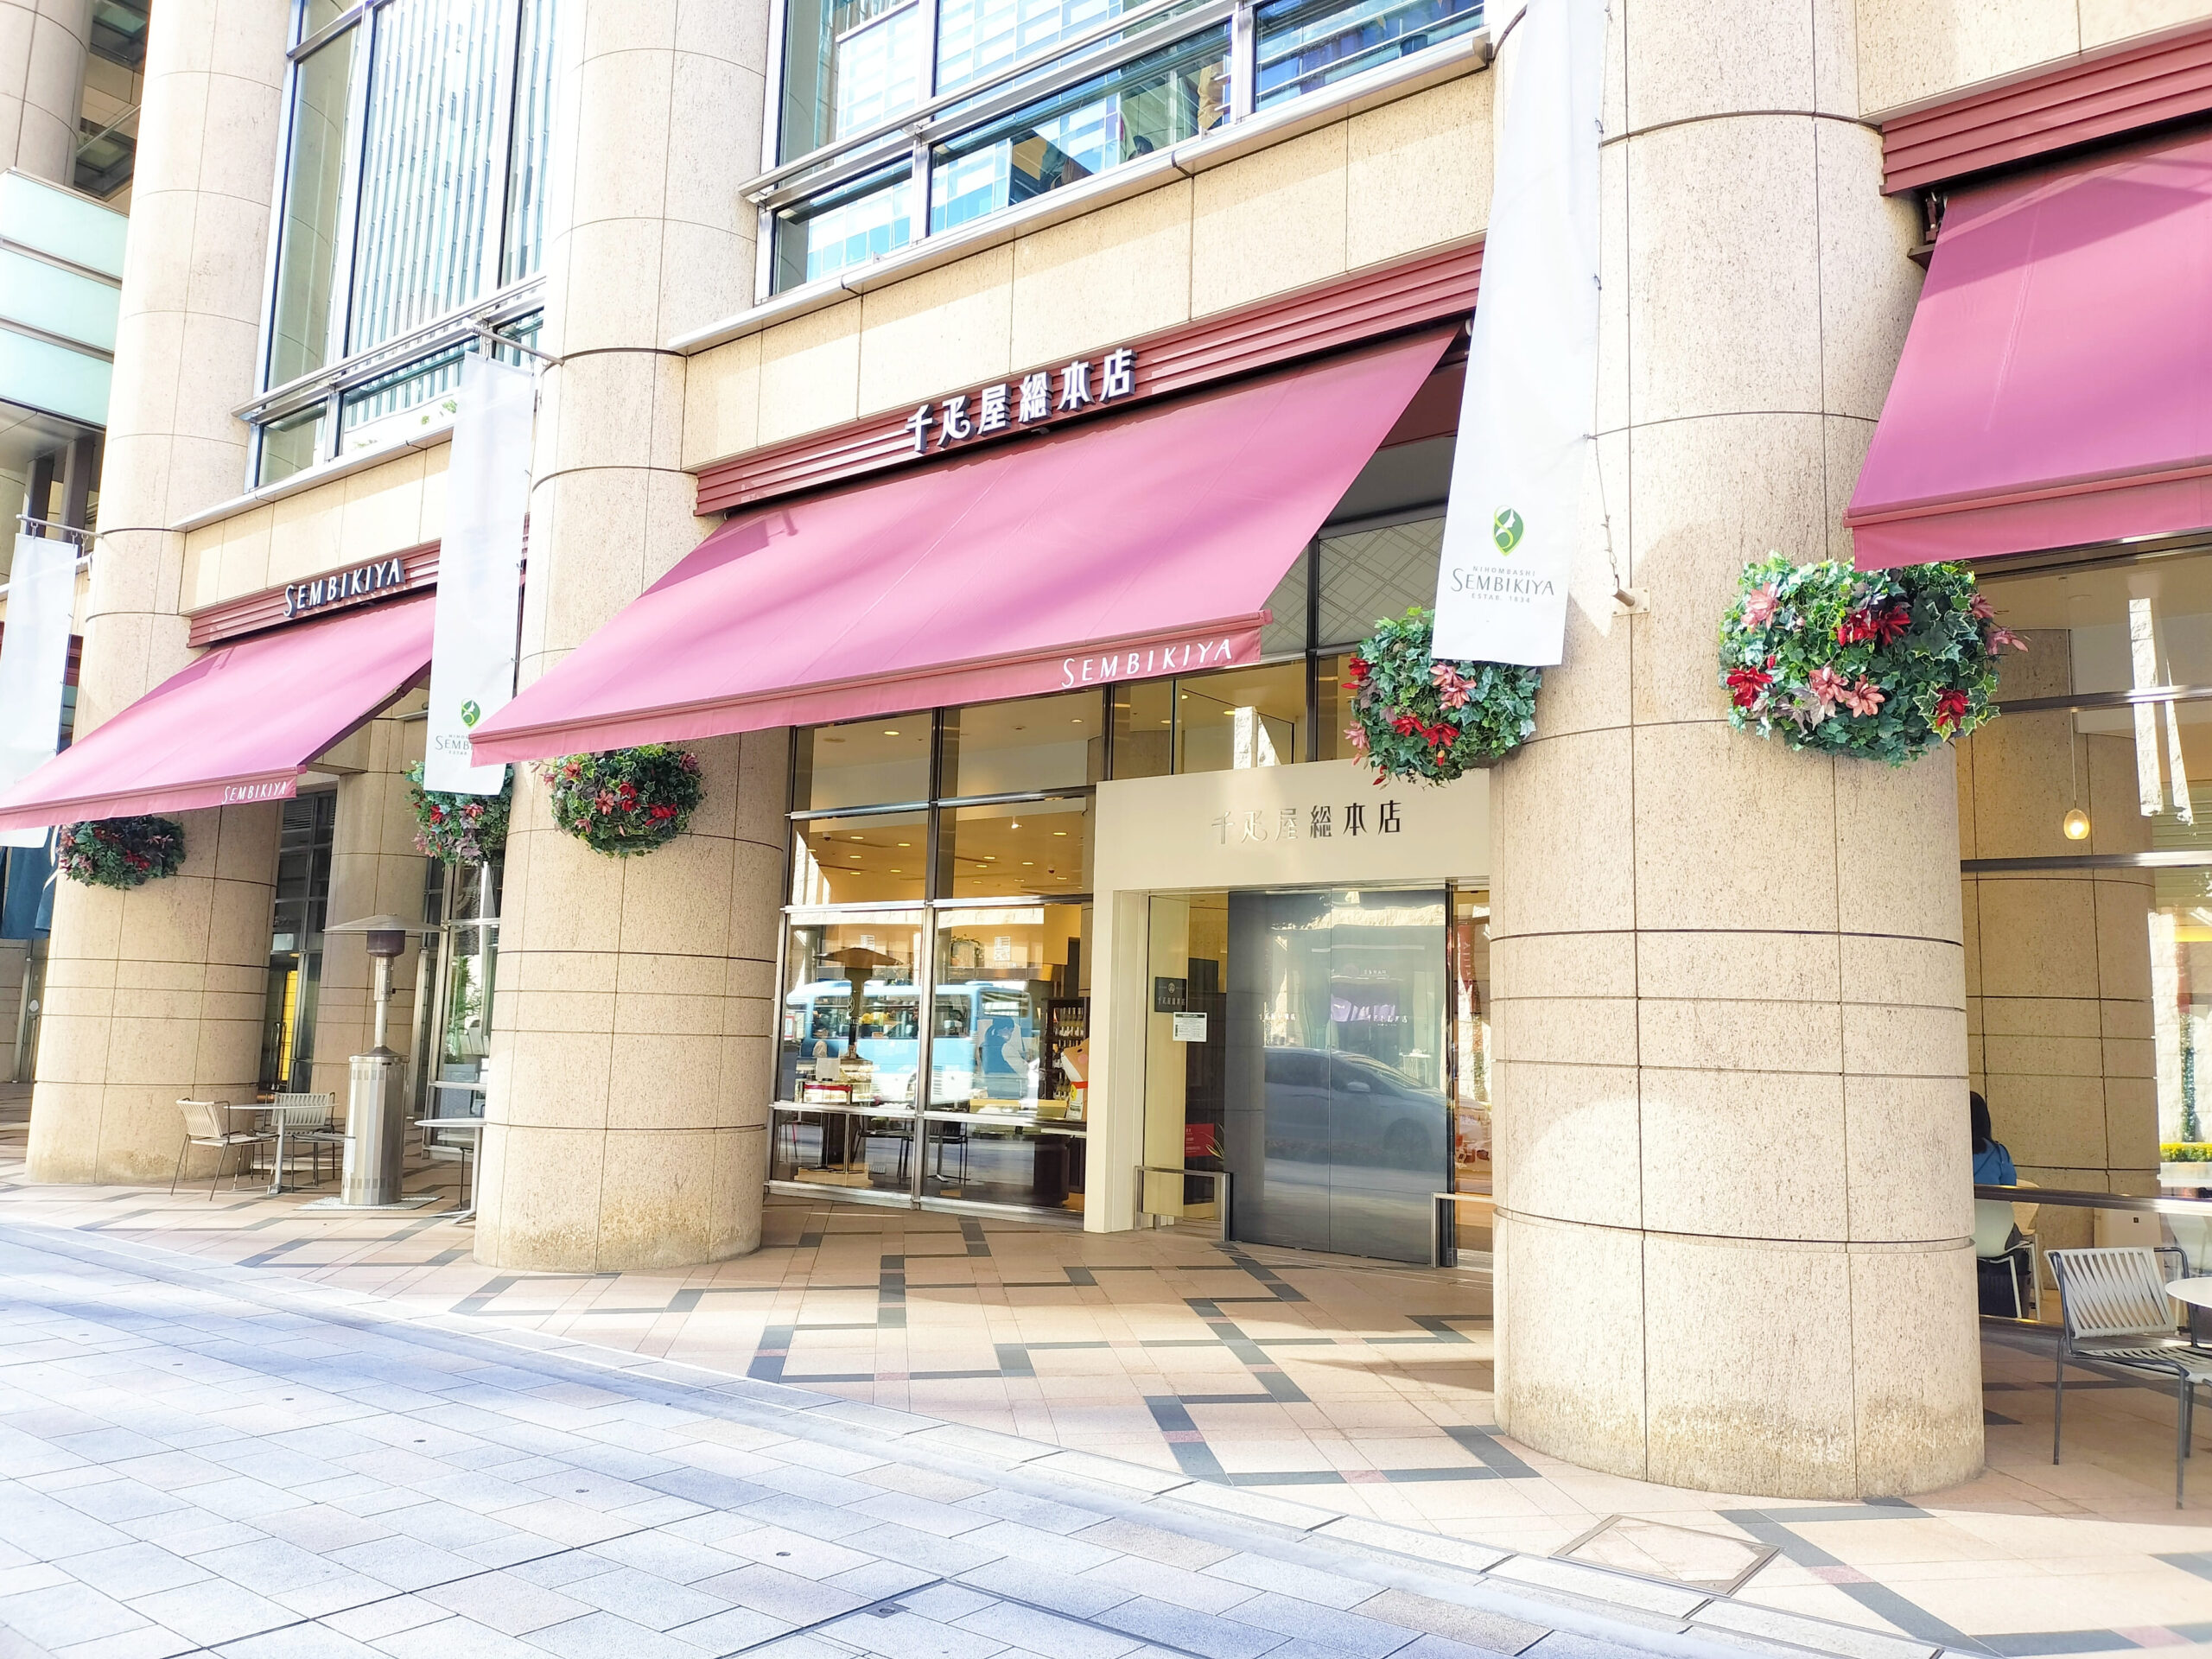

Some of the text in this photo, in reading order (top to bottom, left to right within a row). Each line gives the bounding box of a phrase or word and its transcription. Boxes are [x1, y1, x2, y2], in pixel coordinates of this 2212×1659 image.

[905, 347, 1137, 454] 千疋屋総本店
[283, 557, 404, 618] SEMBIKIYA
[1451, 568, 1554, 596] SEMBIKIYA
[1472, 566, 1535, 576] NIHOMBASHI
[1061, 639, 1232, 689] SEMBIKIYA
[221, 781, 287, 805] SEMBIKIYA
[1211, 799, 1402, 845] 千疋屋総本店
